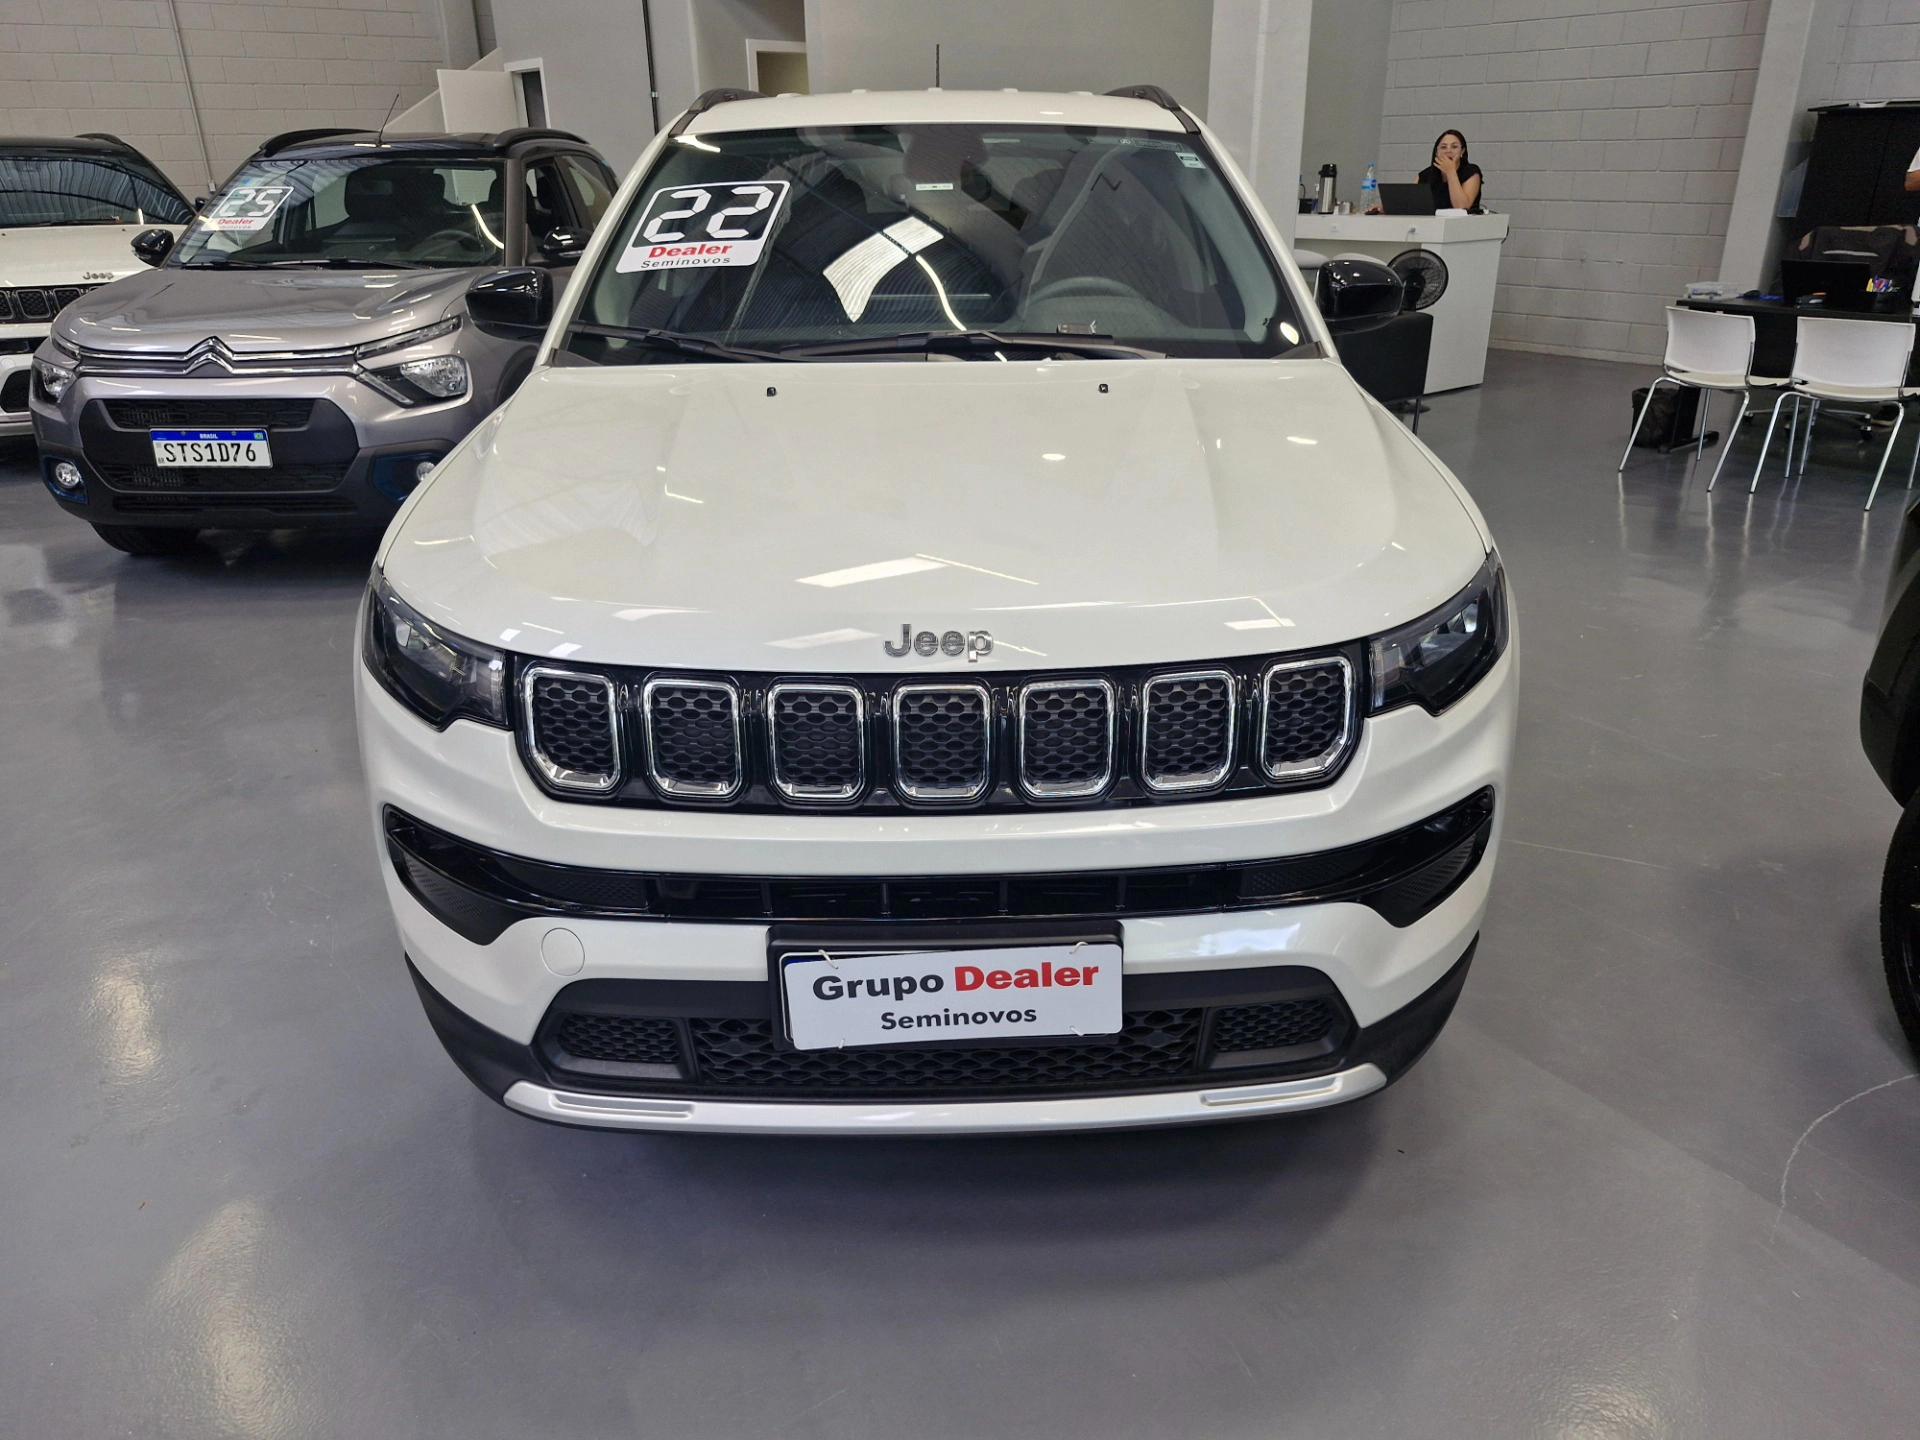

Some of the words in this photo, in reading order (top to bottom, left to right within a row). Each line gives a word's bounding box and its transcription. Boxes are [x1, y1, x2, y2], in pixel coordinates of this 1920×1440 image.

[219, 189, 283, 216] 25
[643, 186, 774, 243] 22
[648, 244, 733, 259] Dealer
[640, 257, 731, 269] Seminovos
[83, 271, 115, 280] Jeep
[163, 443, 256, 463] STS1D76
[884, 623, 994, 663] Jeep
[812, 974, 944, 1001] Grupo
[954, 961, 1099, 991] Dealer
[881, 1008, 1037, 1030] Seminovos
